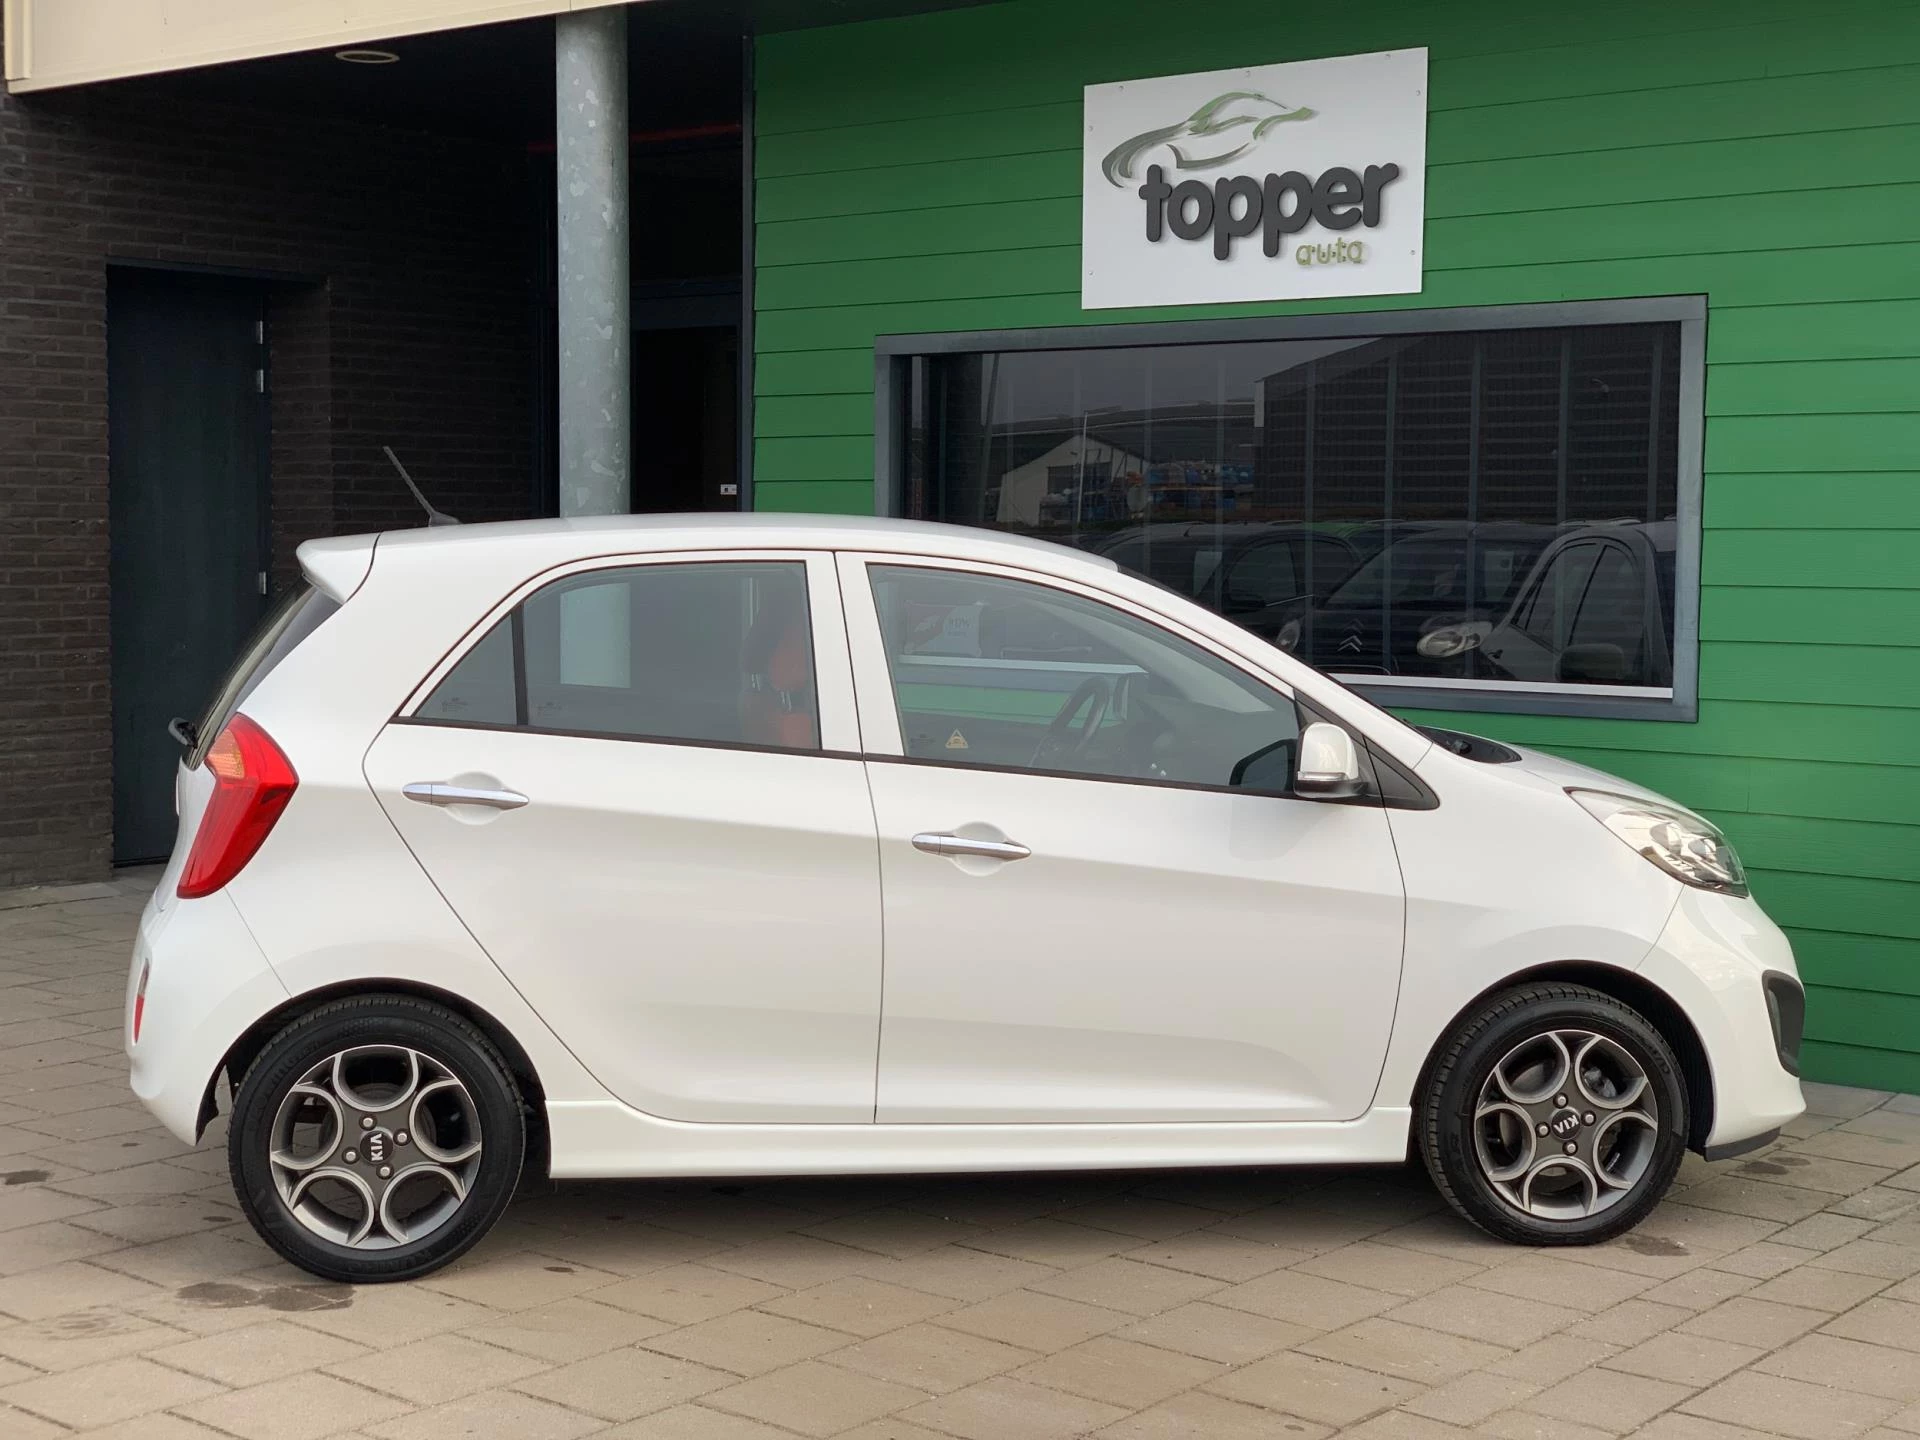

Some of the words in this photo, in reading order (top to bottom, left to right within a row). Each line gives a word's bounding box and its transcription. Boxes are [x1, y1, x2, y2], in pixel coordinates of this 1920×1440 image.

[1139, 163, 1399, 260] topper
[1553, 1114, 1579, 1134] KIA
[370, 1133, 384, 1161] KIA
